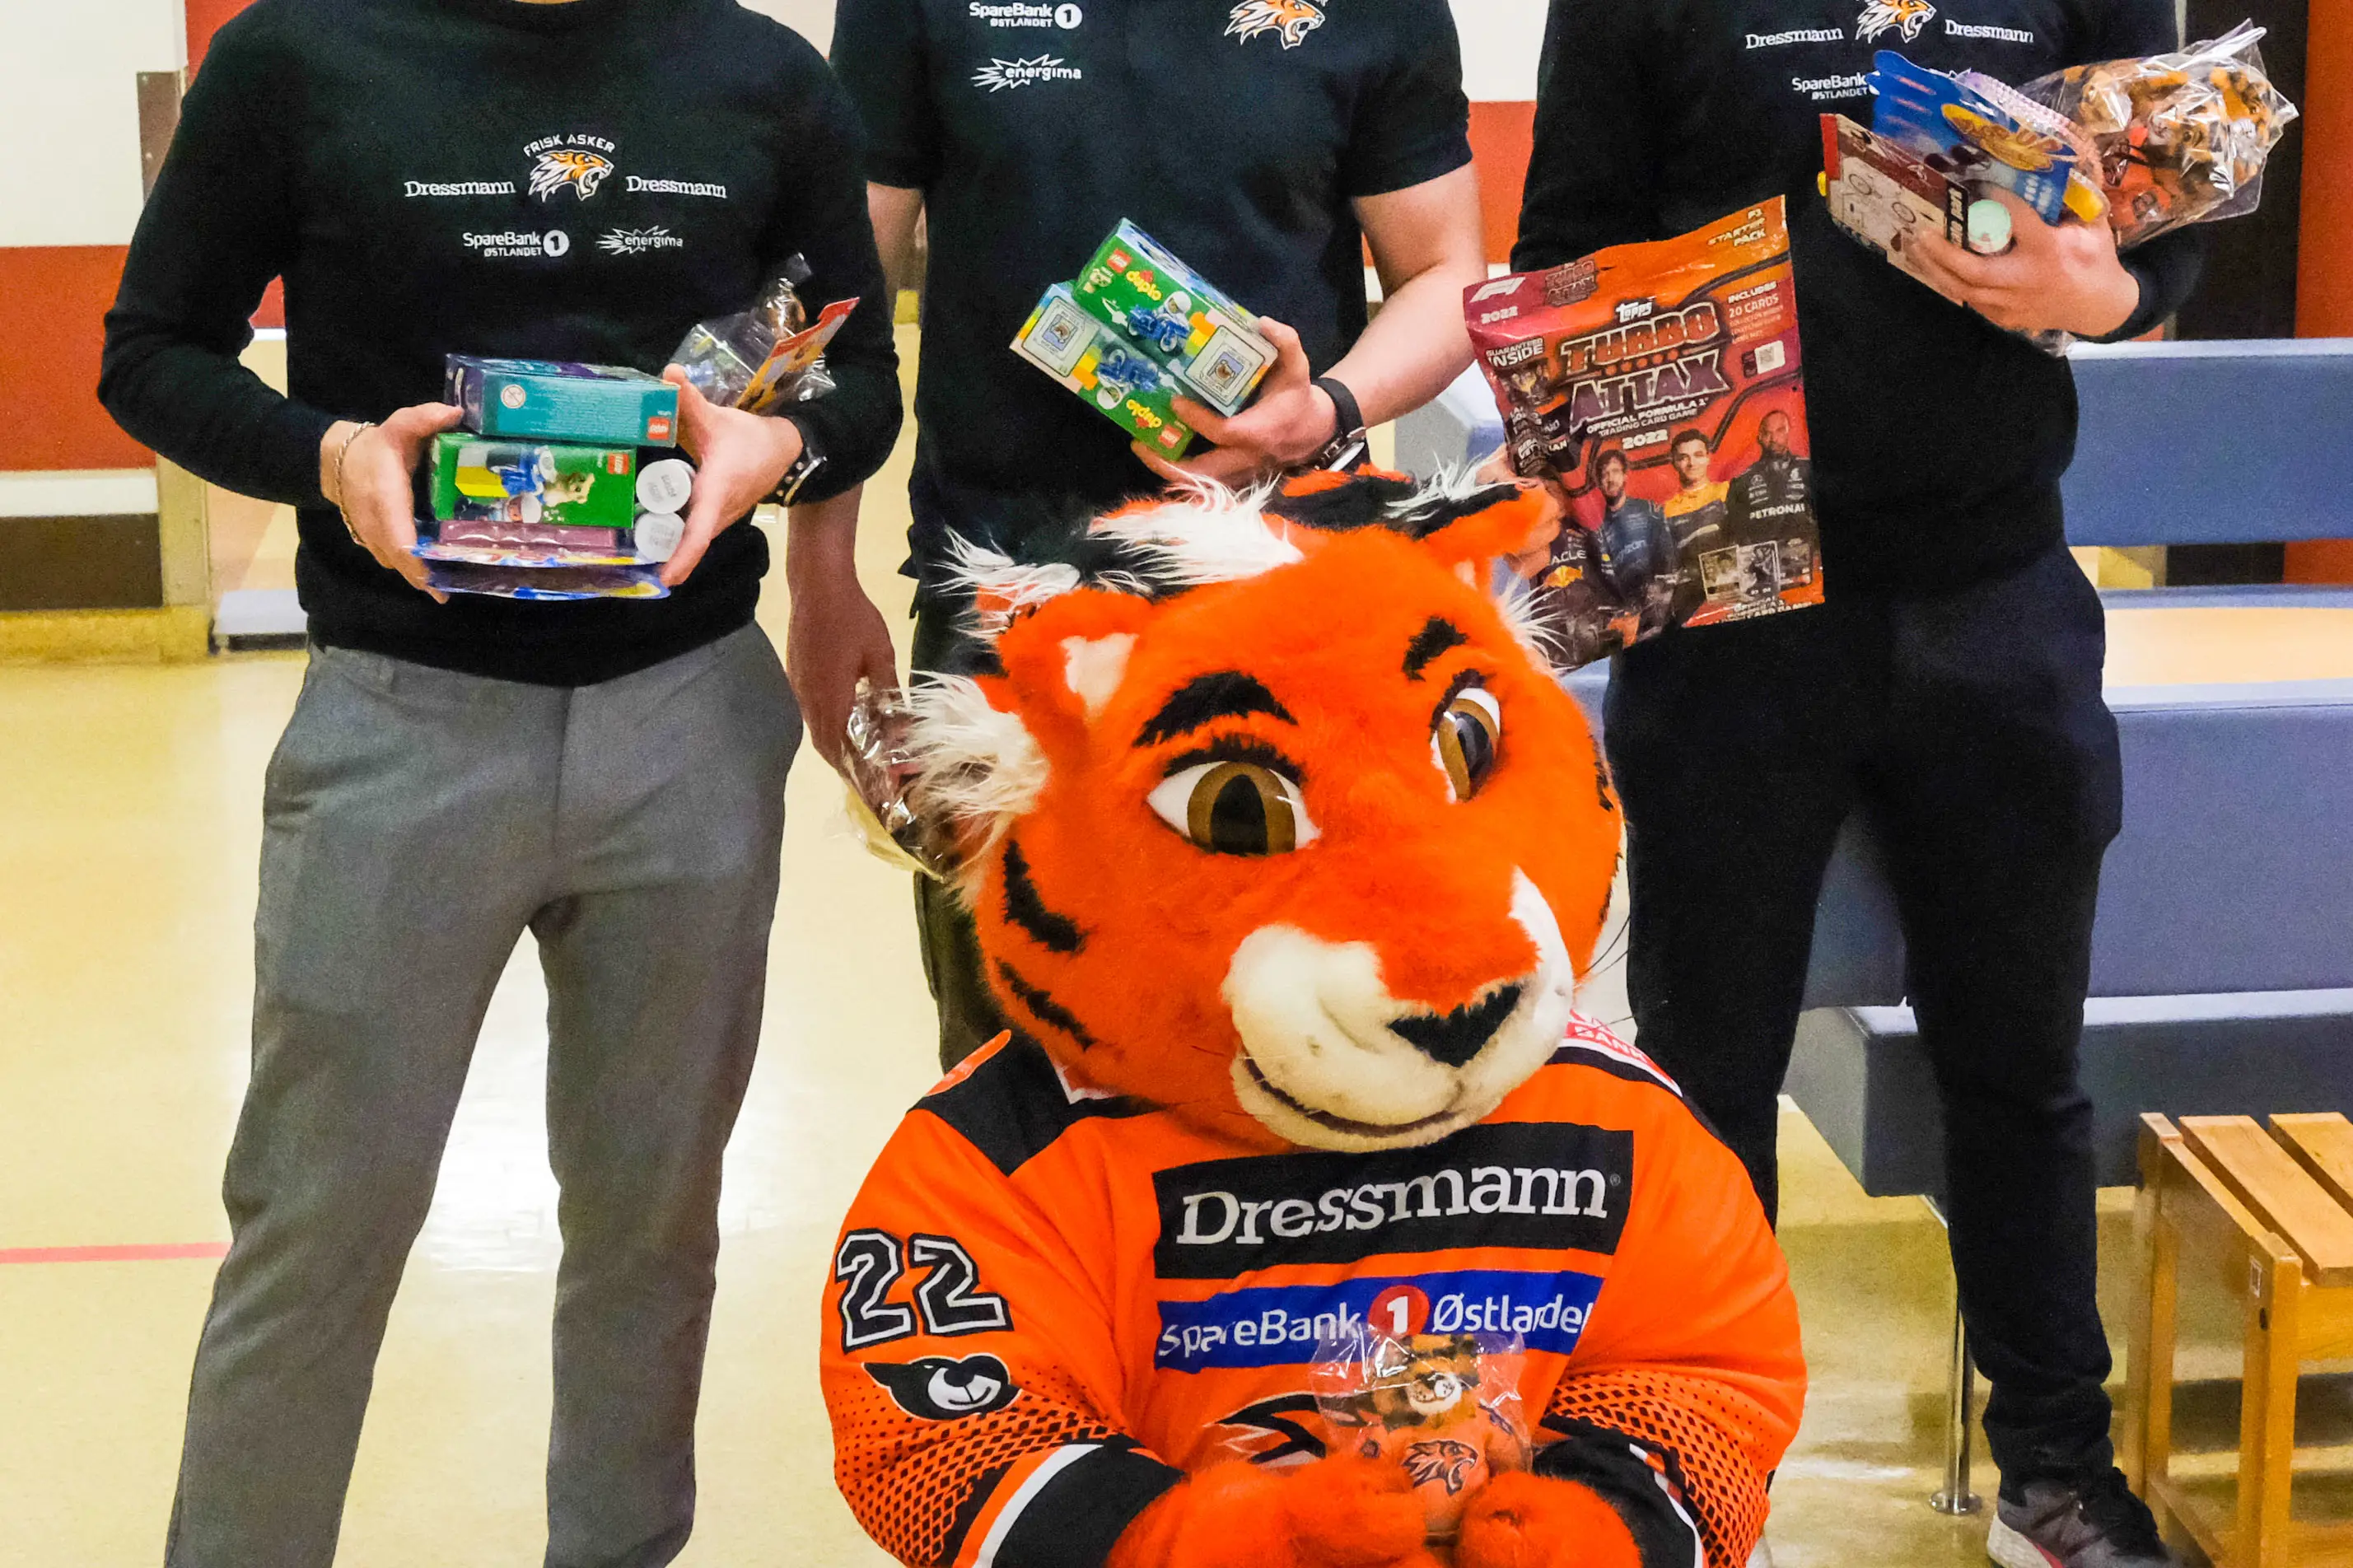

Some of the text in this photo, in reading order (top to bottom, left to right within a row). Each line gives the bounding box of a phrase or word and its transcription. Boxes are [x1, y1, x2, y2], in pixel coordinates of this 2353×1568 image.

[969, 2, 1053, 18] SpareBank
[1745, 27, 1844, 49] Dressmann
[1944, 19, 2034, 44] Dressmann
[1005, 66, 1082, 82] energima
[1792, 72, 1867, 95] SpareBank
[523, 133, 616, 157] FRISK ASKER
[404, 180, 516, 198] Dressmann
[626, 175, 727, 198] Dressmann
[462, 231, 542, 250] SpareBank
[624, 236, 684, 249] energima
[1126, 270, 1162, 301] duplo
[1728, 281, 1777, 304] INCLUDES
[1481, 306, 1519, 324] 2022
[1729, 306, 1743, 319] 20
[1744, 292, 1780, 313] CARDS
[1486, 338, 1543, 357] GUARANTEED
[1561, 301, 1720, 376] TURBO
[1487, 344, 1544, 367] INSIDE
[1569, 348, 1730, 434] ATTAX
[1586, 415, 1638, 434] OFFICIAL
[1638, 400, 1697, 419] FORMULA
[1599, 408, 1697, 437] TRADING CARD GAME
[1622, 429, 1669, 450] 2022
[835, 1228, 1015, 1355] 22
[1158, 1301, 1361, 1358] SpareBank
